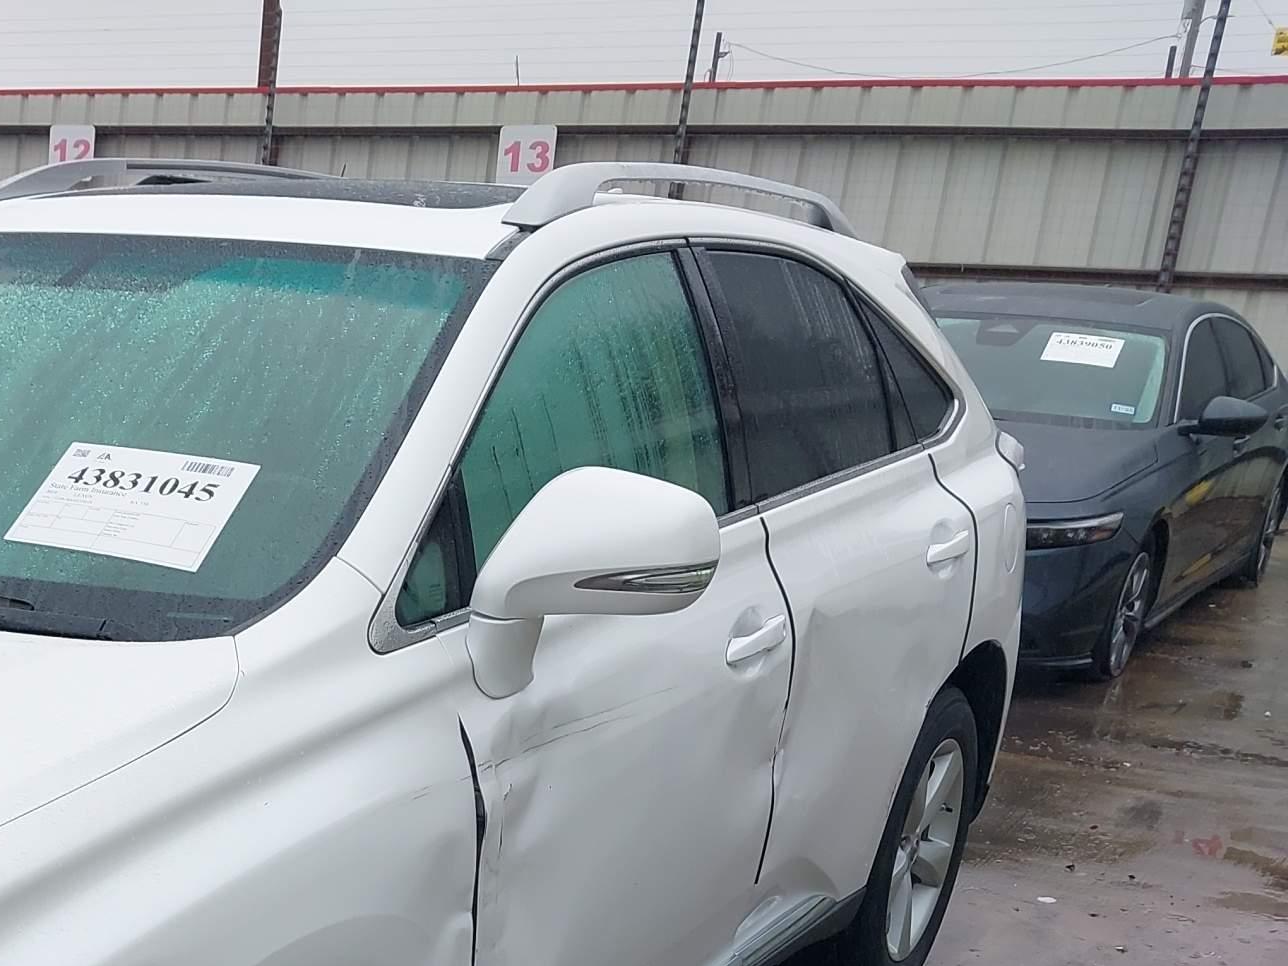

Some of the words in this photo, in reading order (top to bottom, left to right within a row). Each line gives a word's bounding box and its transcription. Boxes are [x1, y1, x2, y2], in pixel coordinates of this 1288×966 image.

[53, 138, 91, 163] 12
[503, 140, 551, 173] 13
[67, 466, 221, 502] 43831045
